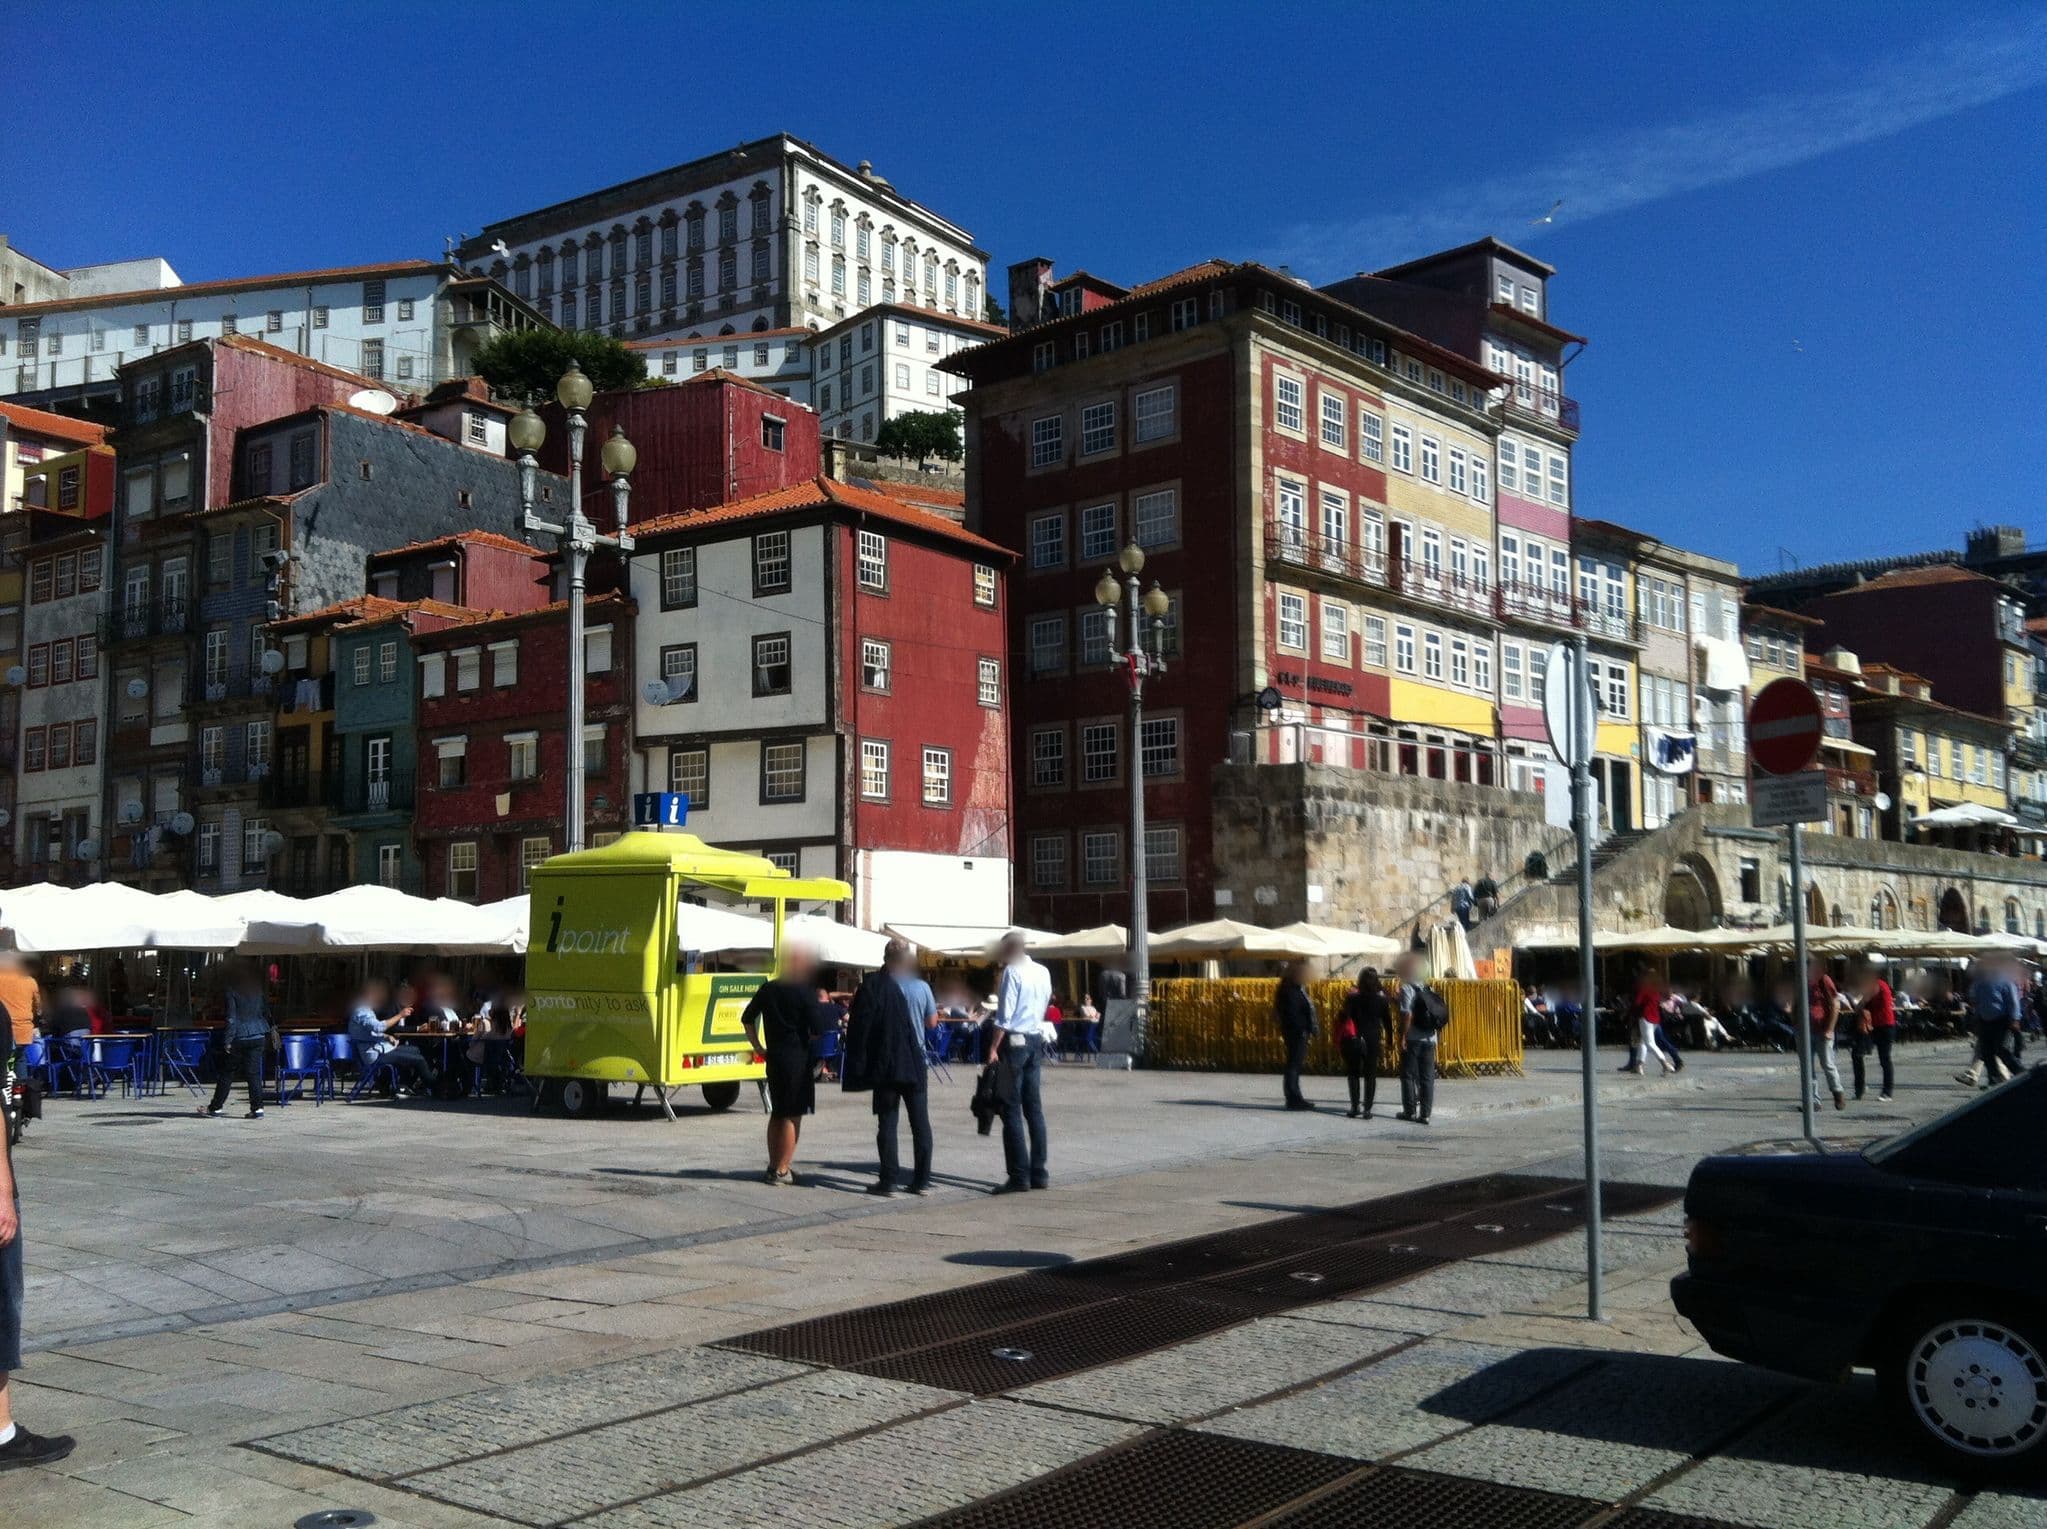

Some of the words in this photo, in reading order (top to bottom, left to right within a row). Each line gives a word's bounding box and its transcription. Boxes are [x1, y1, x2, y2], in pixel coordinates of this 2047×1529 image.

[669, 796, 679, 824] i
[606, 995, 620, 1012] to
[625, 998, 649, 1013] ask
